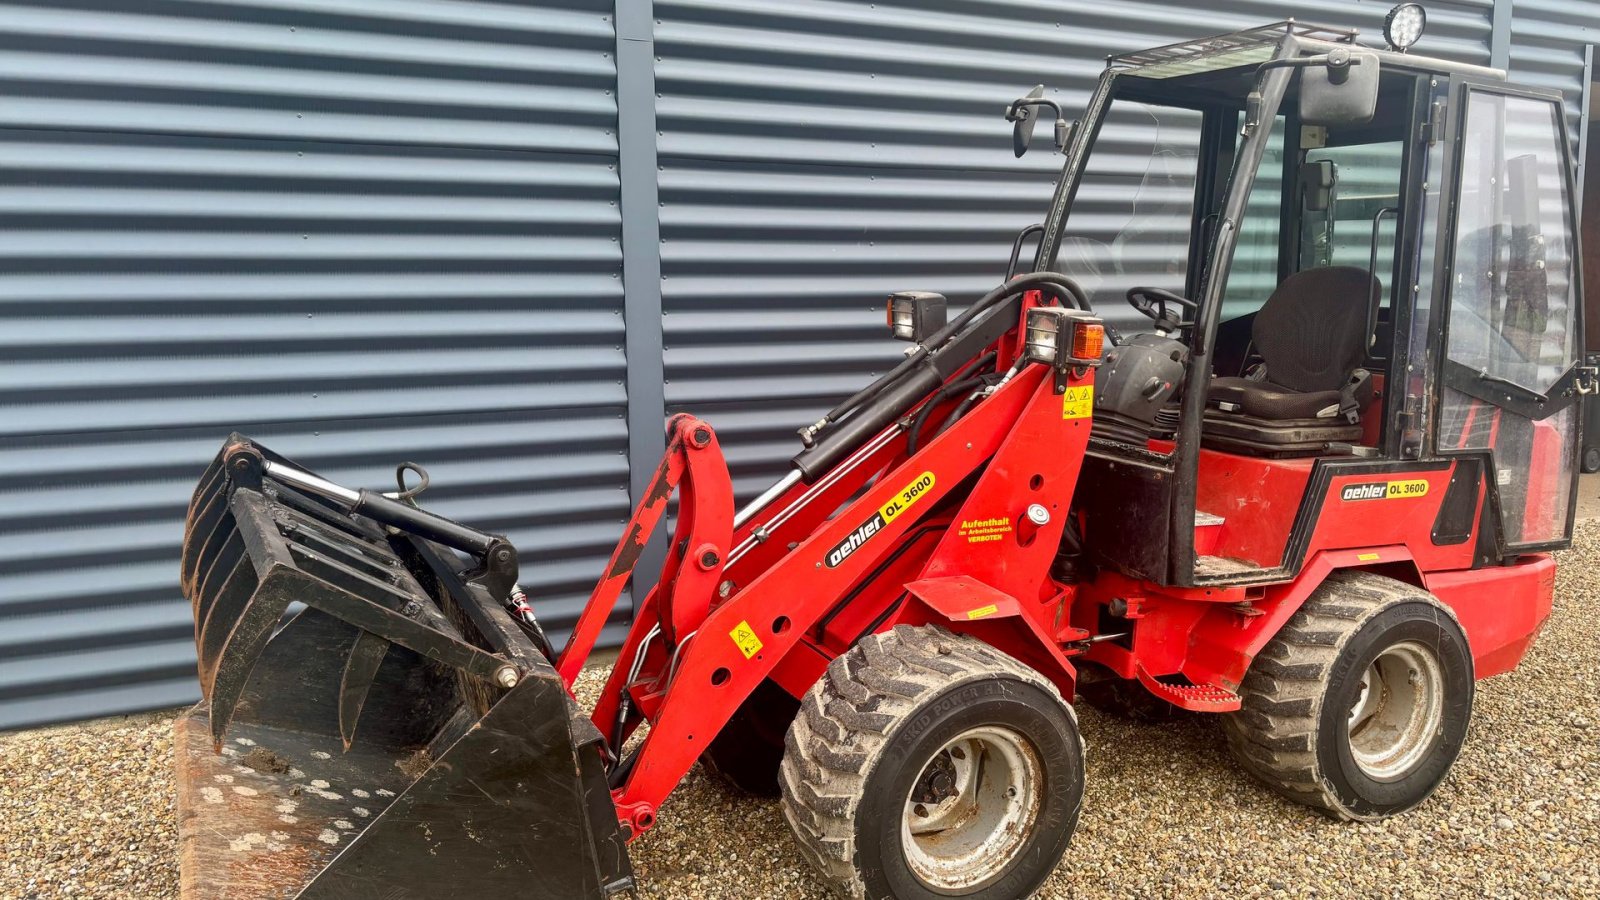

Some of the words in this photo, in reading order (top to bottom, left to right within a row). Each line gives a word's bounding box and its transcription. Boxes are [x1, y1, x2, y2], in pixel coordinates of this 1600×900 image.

[1343, 485, 1387, 500] oehler
[1389, 485, 1402, 495] OL
[1404, 483, 1426, 494] 3600
[830, 515, 881, 567] oehler
[885, 502, 903, 517] OL
[903, 476, 931, 503] 3600
[961, 517, 1010, 529] Aufenthalt
[968, 526, 1013, 535] Arbeitsbereich
[967, 534, 1003, 543] VERBOTEN
[902, 713, 932, 745] SKID
[934, 687, 979, 716] POWER
